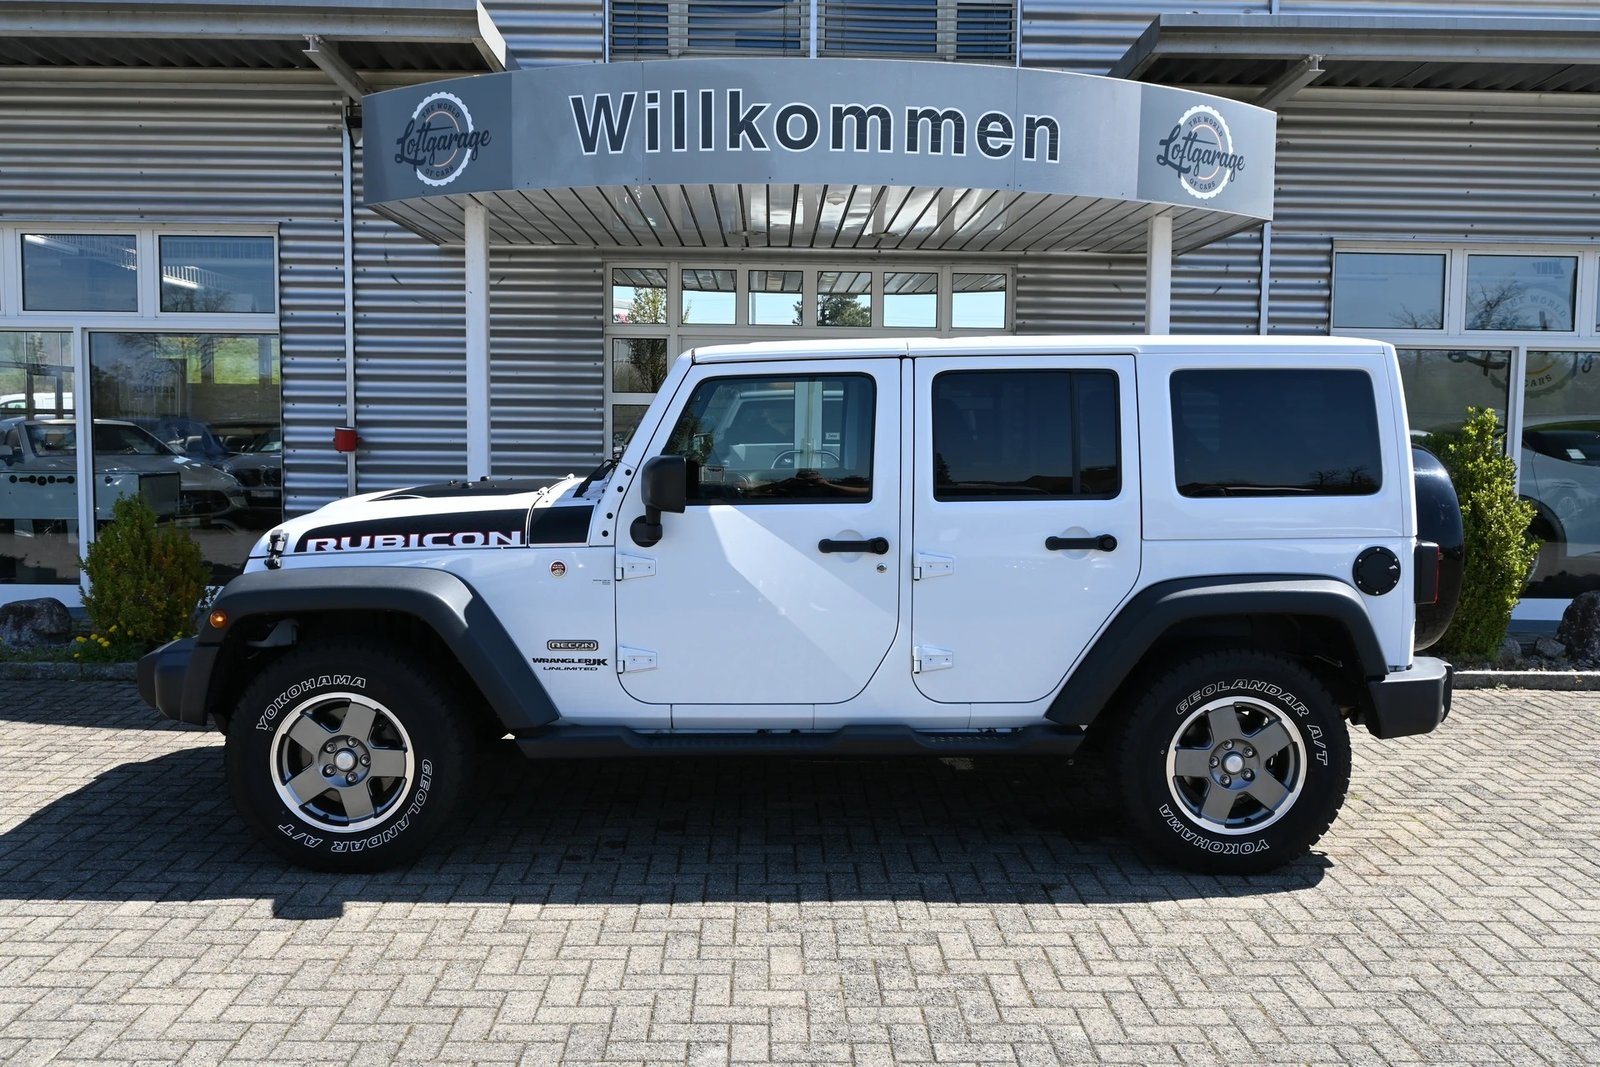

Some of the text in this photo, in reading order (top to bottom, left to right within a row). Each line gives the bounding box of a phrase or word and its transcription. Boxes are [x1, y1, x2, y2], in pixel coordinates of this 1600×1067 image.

[421, 103, 461, 119] THE WORLD
[568, 88, 1061, 164] Willkommen
[1188, 116, 1224, 138] THE WORLD
[394, 119, 492, 172] Loftgarage
[1156, 124, 1246, 183] Loftgarage
[425, 168, 434, 177] OF
[1189, 178, 1216, 190] OF CARS
[305, 531, 519, 552] RUBICON
[256, 675, 367, 731] YOKOHAMA
[1175, 679, 1329, 766] GEOLANDAR A/T
[278, 758, 433, 853] GEOLANDAR A/T
[1159, 803, 1270, 855] YOKOHAMA
